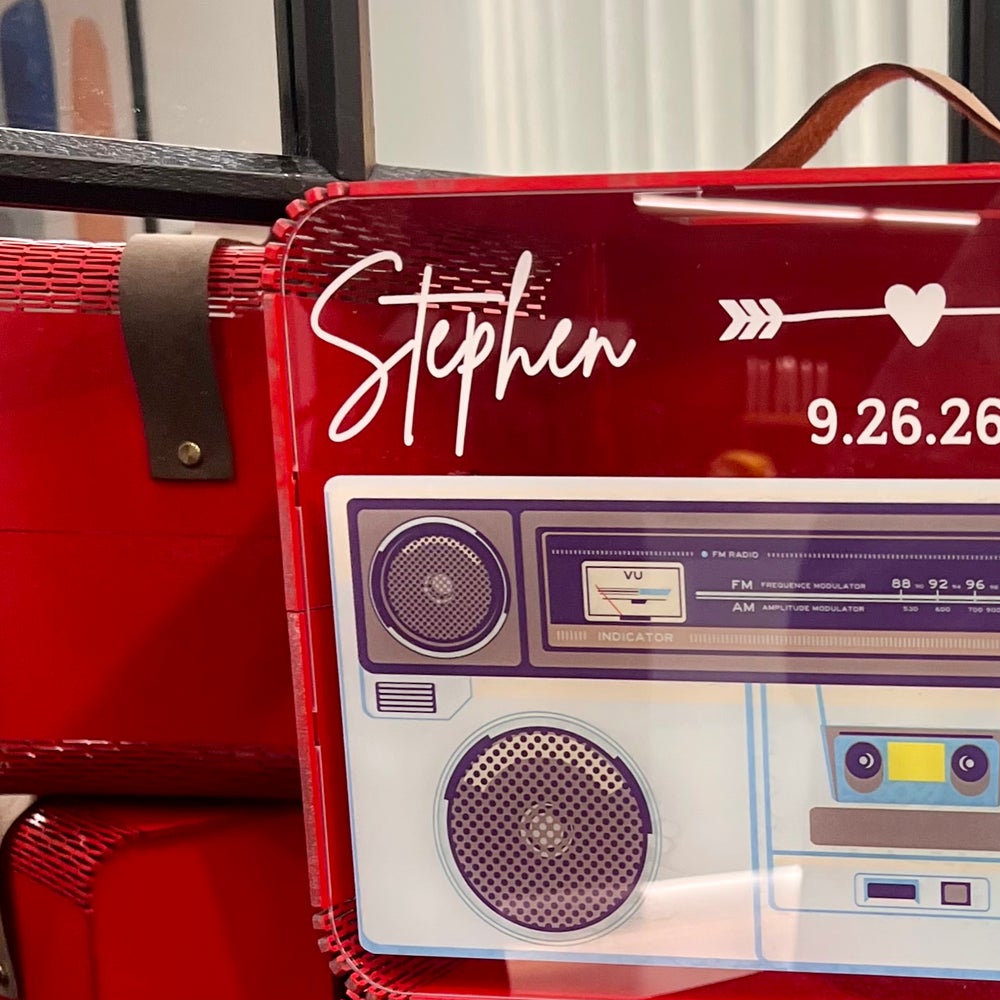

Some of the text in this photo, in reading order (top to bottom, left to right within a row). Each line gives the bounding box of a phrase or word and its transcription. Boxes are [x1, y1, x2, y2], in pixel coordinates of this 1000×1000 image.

[310, 250, 636, 457] Stephen
[728, 551, 759, 559] RADIO
[623, 570, 643, 580] VU
[731, 580, 753, 590] FM
[813, 582, 866, 590] MODULATOR
[891, 578, 911, 589] 88
[928, 579, 948, 589] 92
[965, 579, 985, 590] 96
[732, 603, 865, 612] AM AMPLITUDE MODULATOR
[598, 632, 674, 642] INDICATOR
